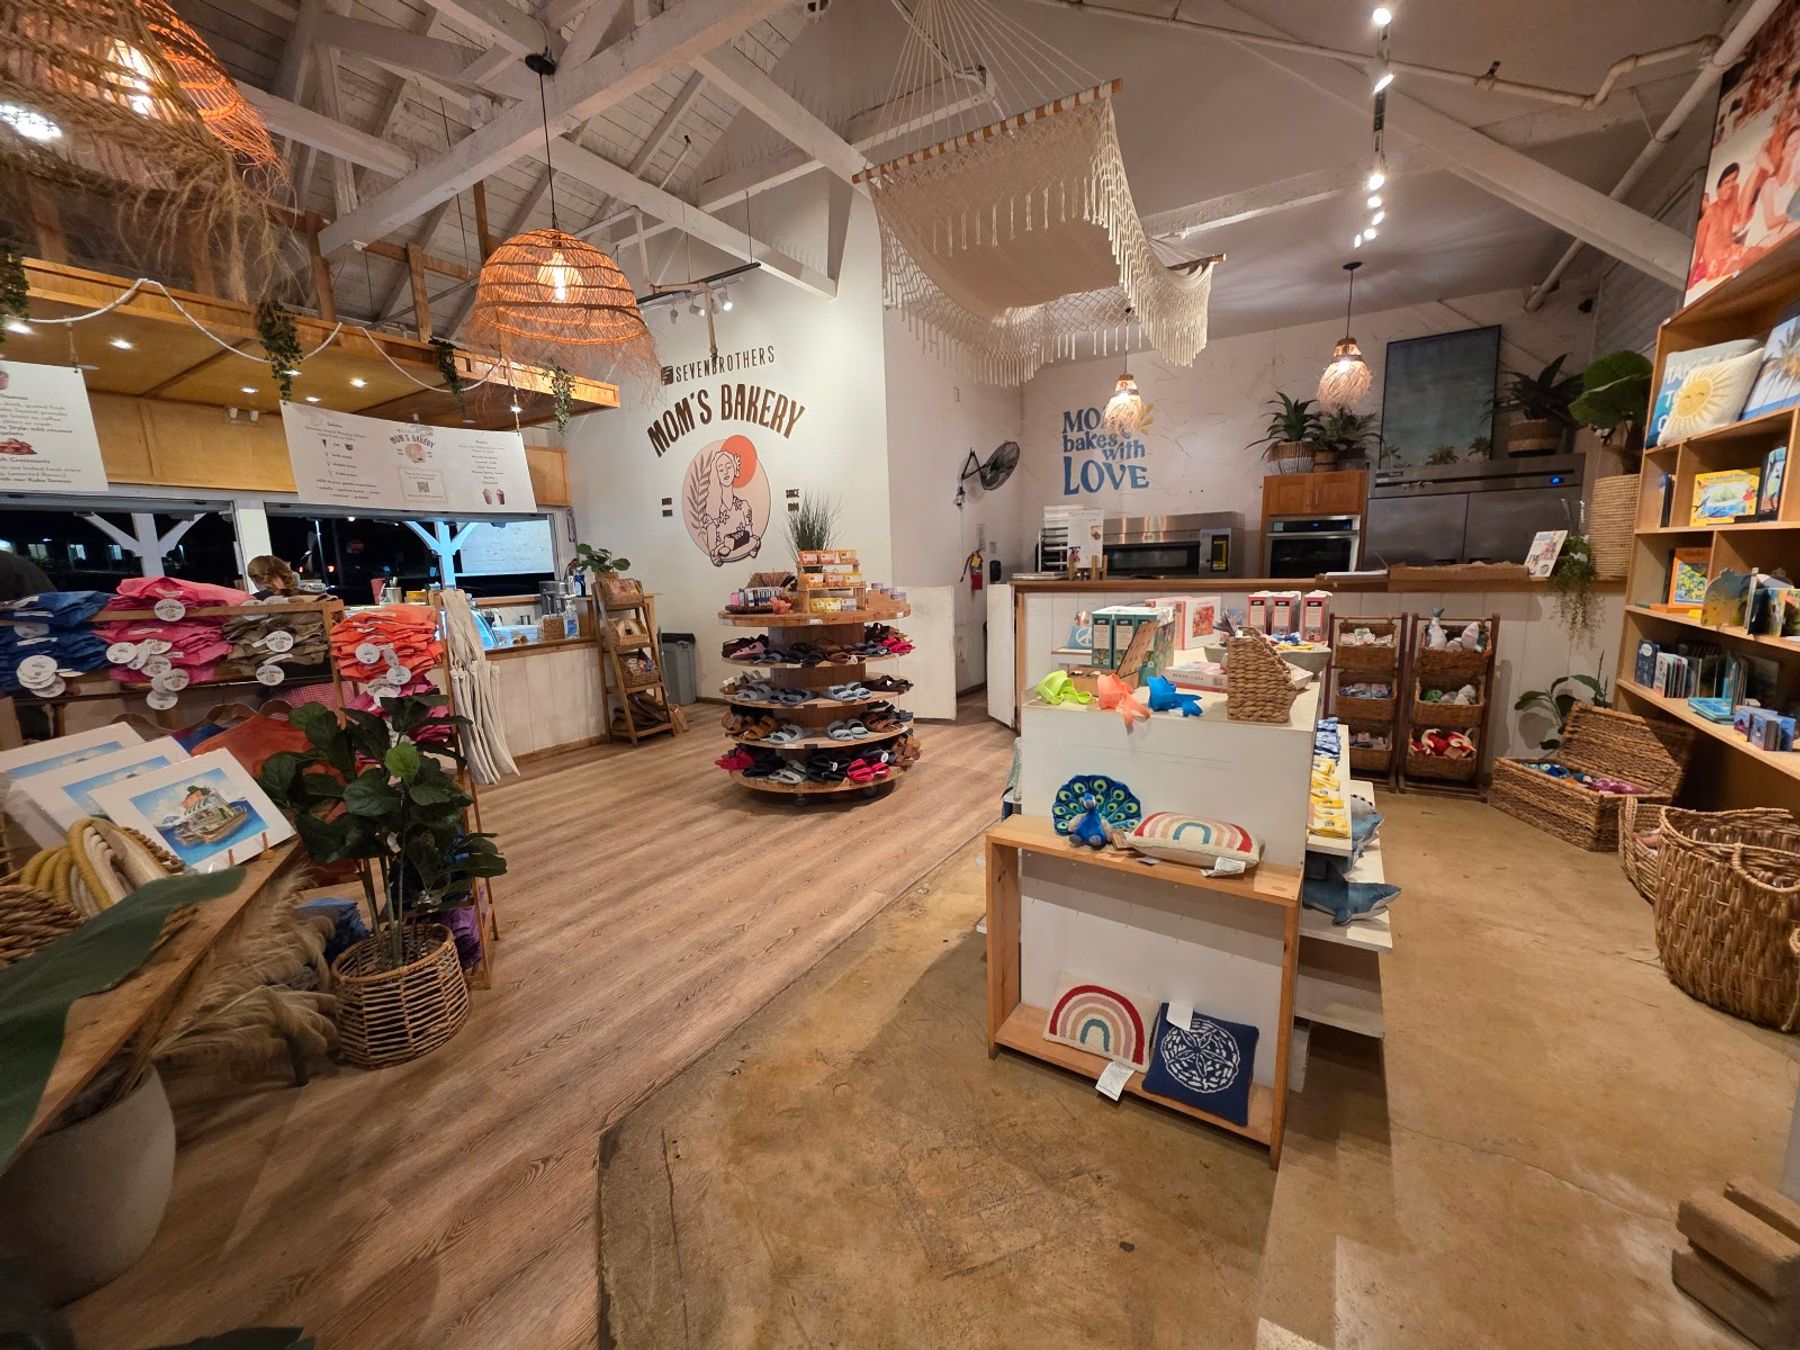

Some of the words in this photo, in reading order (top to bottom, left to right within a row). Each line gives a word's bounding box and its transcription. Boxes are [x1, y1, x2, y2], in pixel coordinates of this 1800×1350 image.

[675, 345, 775, 383] SEVENBROTHERS
[646, 389, 713, 458] MOM'S
[720, 383, 806, 440] BAKERY
[1062, 431, 1118, 453] bakes
[1101, 440, 1146, 461] with
[1063, 455, 1149, 496] LOVE
